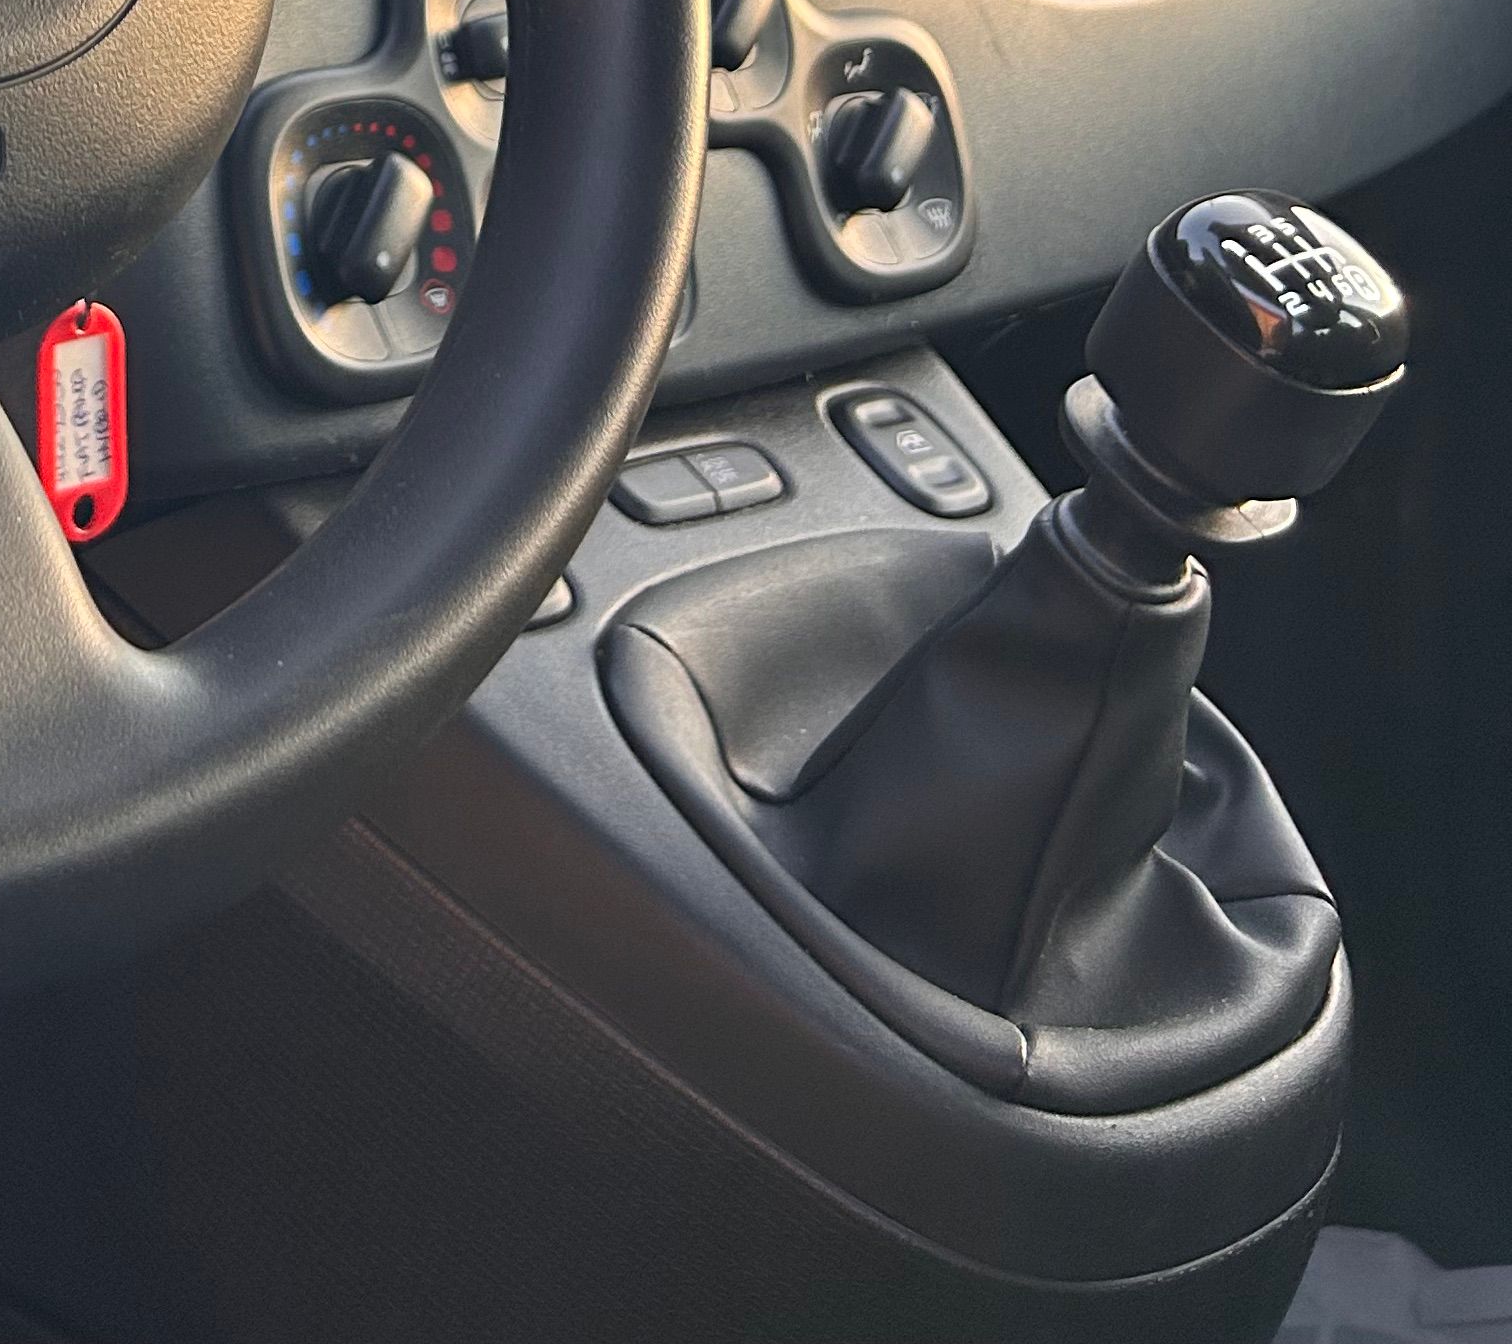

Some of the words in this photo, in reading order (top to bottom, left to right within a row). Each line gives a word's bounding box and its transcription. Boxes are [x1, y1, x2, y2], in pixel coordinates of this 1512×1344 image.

[1247, 224, 1275, 244] 3
[1270, 216, 1296, 236] 5
[1278, 290, 1310, 318] 2
[1307, 279, 1335, 303] 4
